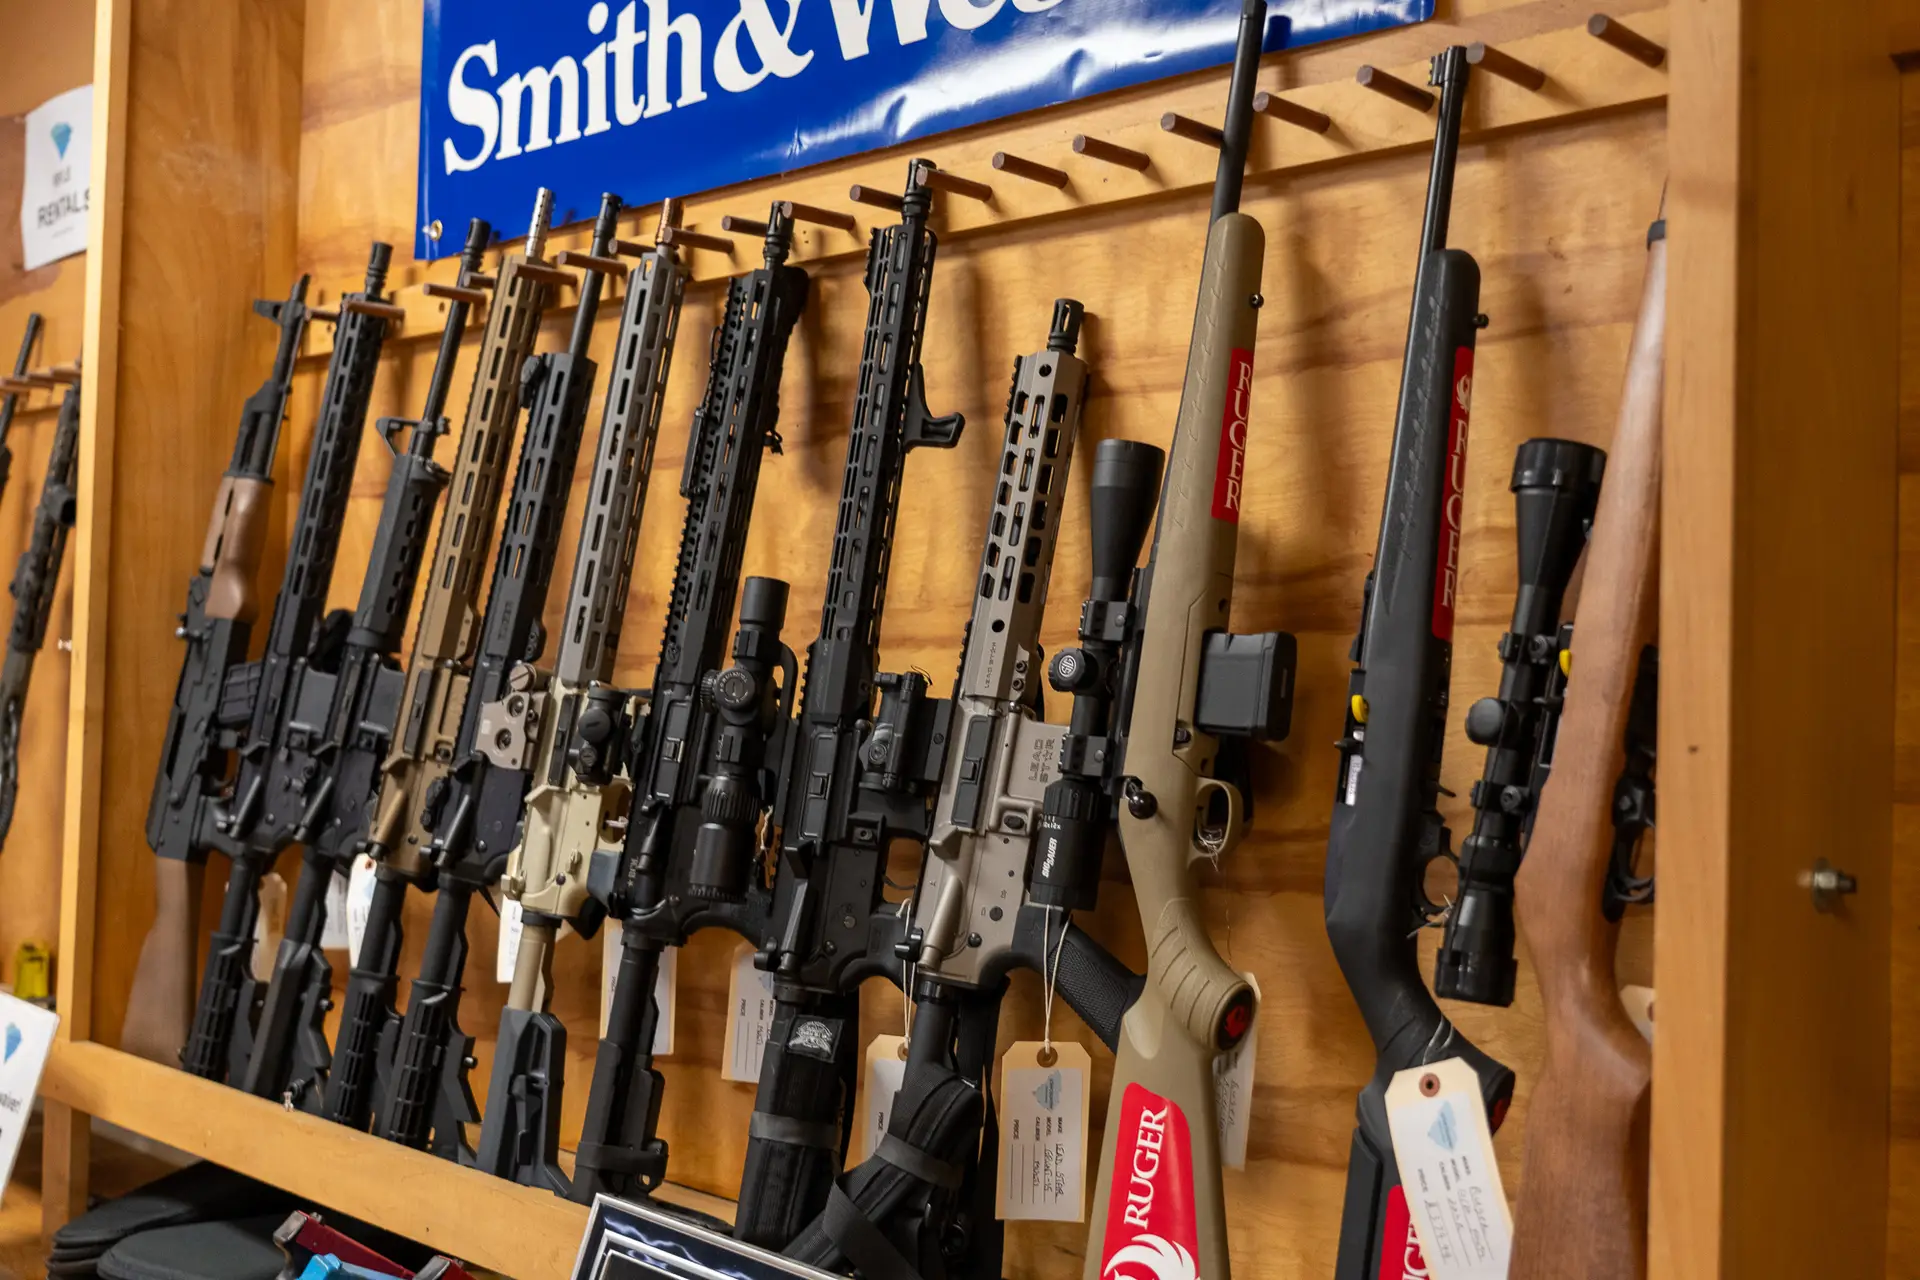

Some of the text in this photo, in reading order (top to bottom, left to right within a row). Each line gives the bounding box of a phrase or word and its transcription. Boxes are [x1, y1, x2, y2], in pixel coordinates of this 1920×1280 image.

[444, 0, 707, 175] Smith
[713, 0, 814, 93] &
[1223, 361, 1251, 512] RUGER
[1028, 738, 1044, 781] LEAD
[1047, 837, 1058, 866] SAUER
[1124, 1105, 1168, 1230] RUGER
